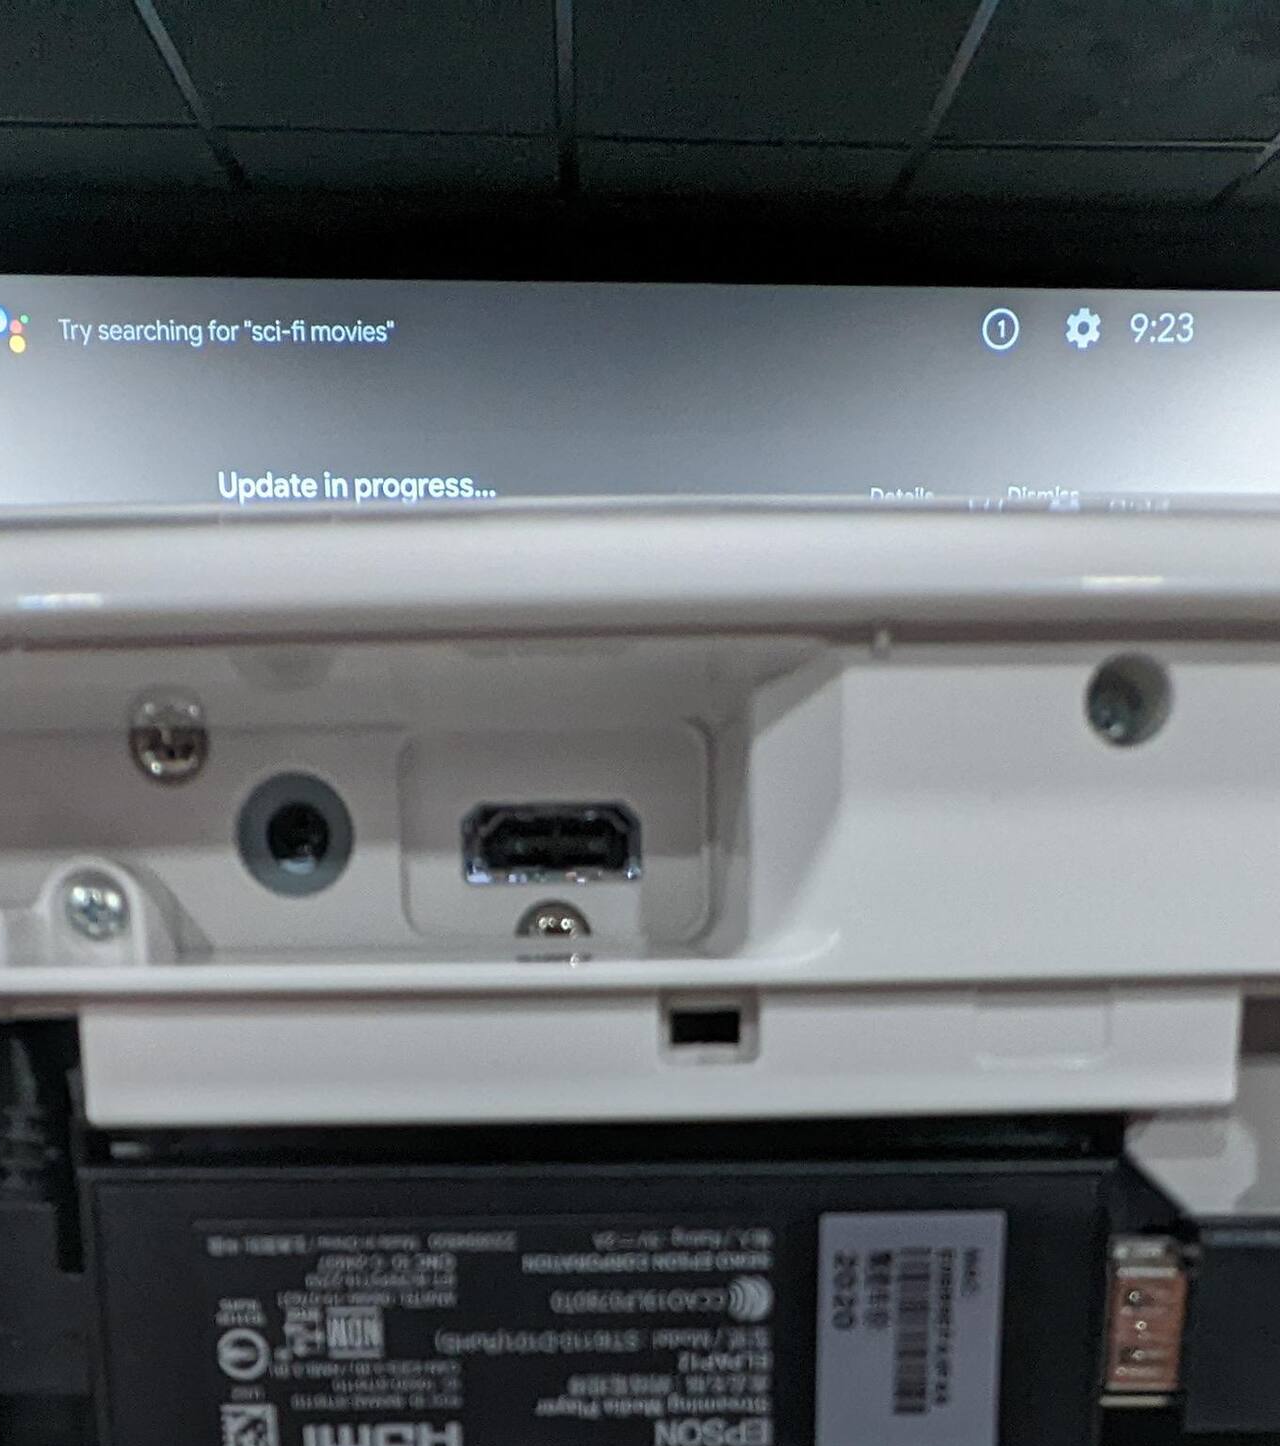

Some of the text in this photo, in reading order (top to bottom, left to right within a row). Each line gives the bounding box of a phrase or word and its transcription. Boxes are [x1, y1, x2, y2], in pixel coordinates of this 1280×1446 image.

[58, 318, 395, 347] Try searching for "sci-fi movies"
[1130, 312, 1195, 343] 9:23
[218, 472, 496, 502] Update in progress...
[601, 1398, 664, 1415] Media
